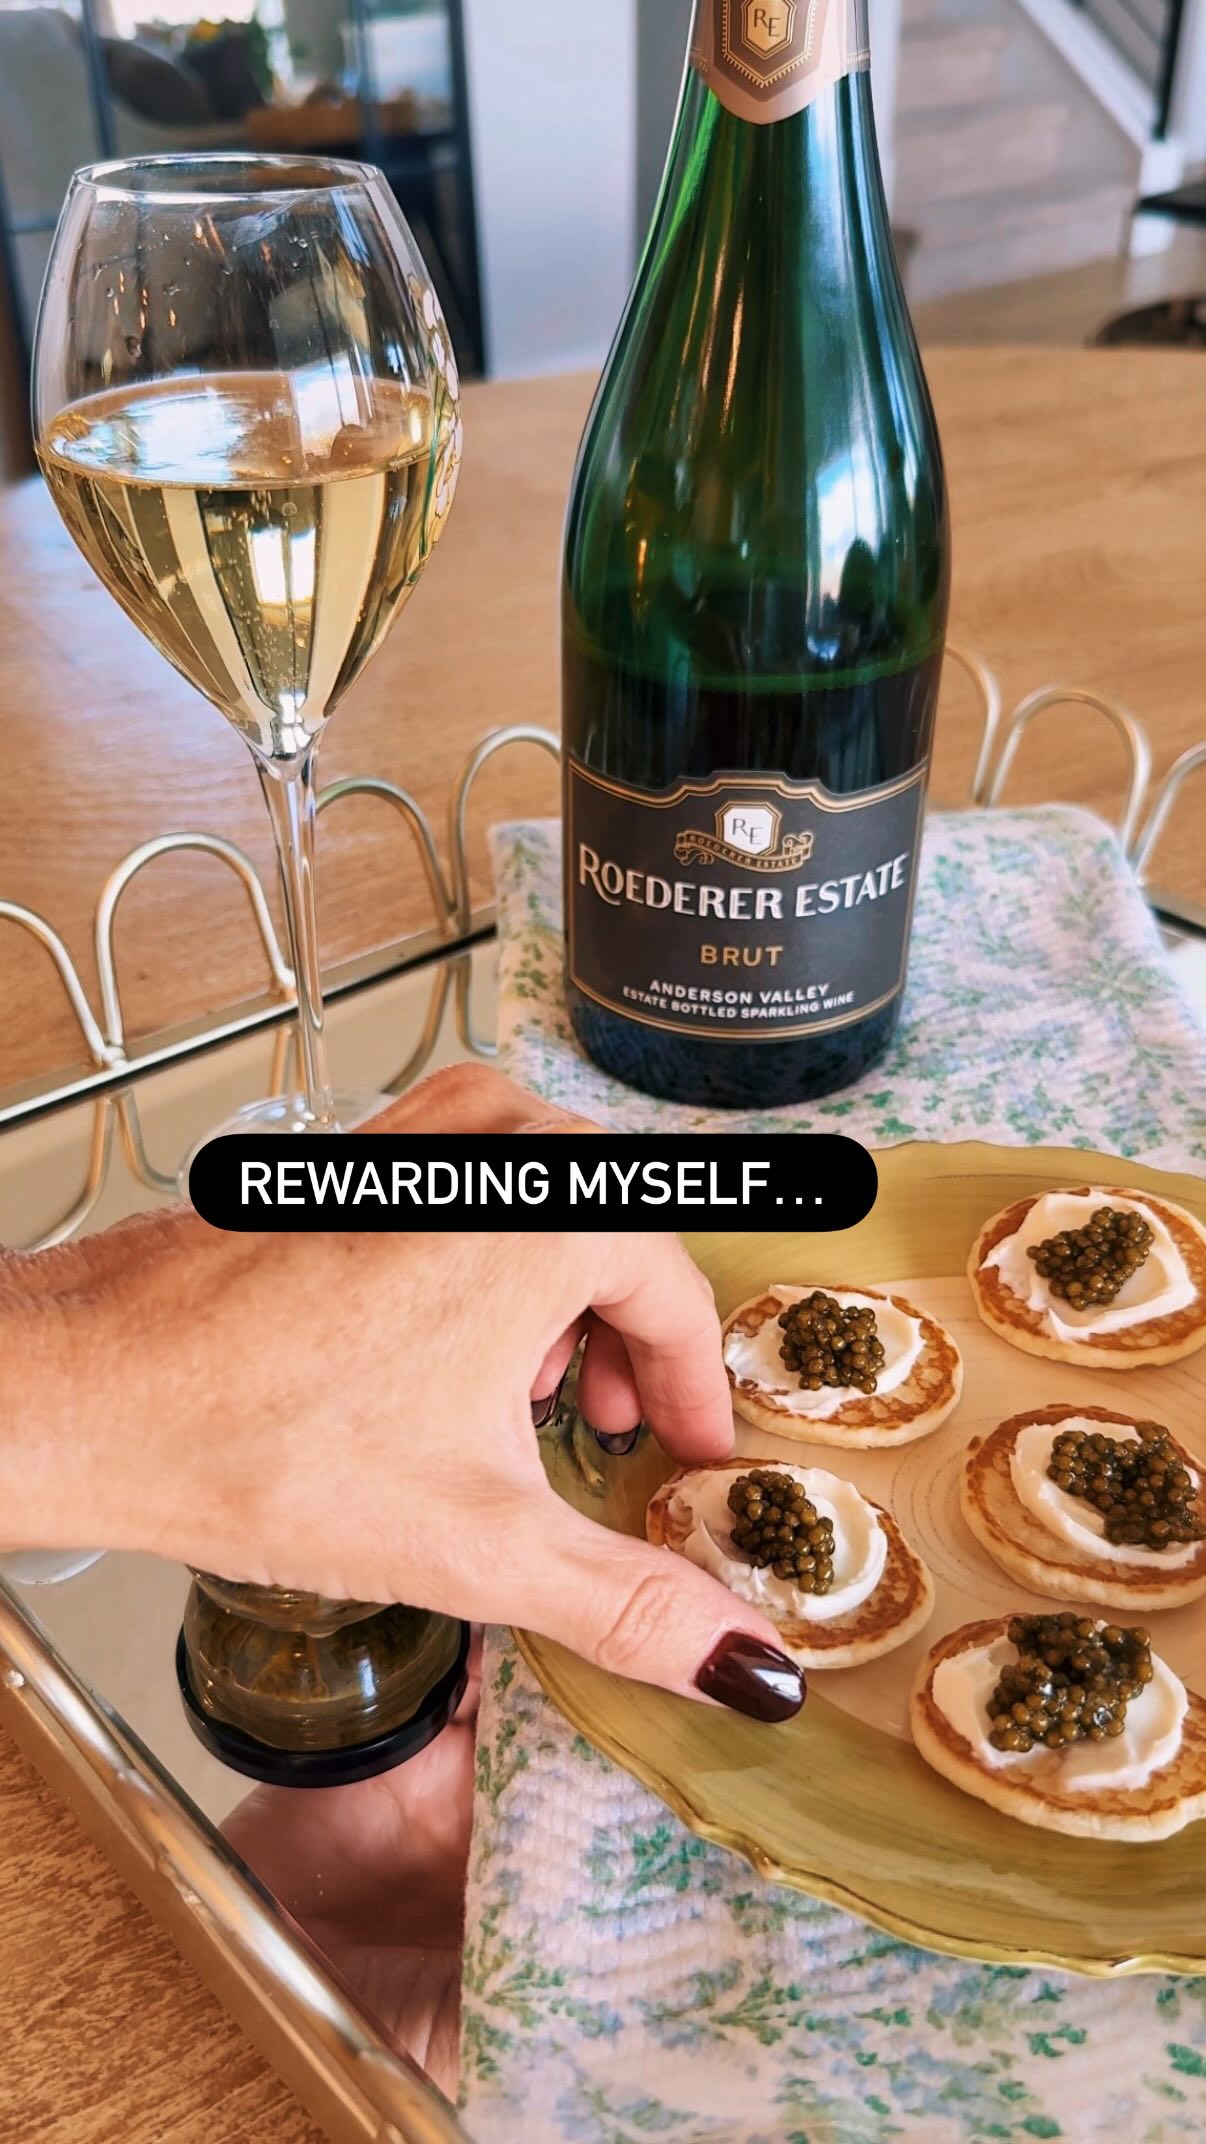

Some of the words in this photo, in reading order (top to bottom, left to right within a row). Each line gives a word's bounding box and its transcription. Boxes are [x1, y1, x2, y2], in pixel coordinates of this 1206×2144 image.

[753, 8, 780, 37] RE
[731, 817, 763, 845] RE
[755, 858, 798, 870] ESTATE
[578, 843, 783, 920] ROEDERER
[795, 852, 909, 917] ESTATE
[700, 945, 784, 966] BRUT
[622, 986, 668, 1009] ESTATE
[671, 1001, 737, 1019] BOTTLED
[740, 1002, 820, 1019] SPARKLING
[822, 991, 855, 1010] WINE
[649, 979, 752, 1004] ANDERSON
[759, 982, 830, 1004] VALLEY
